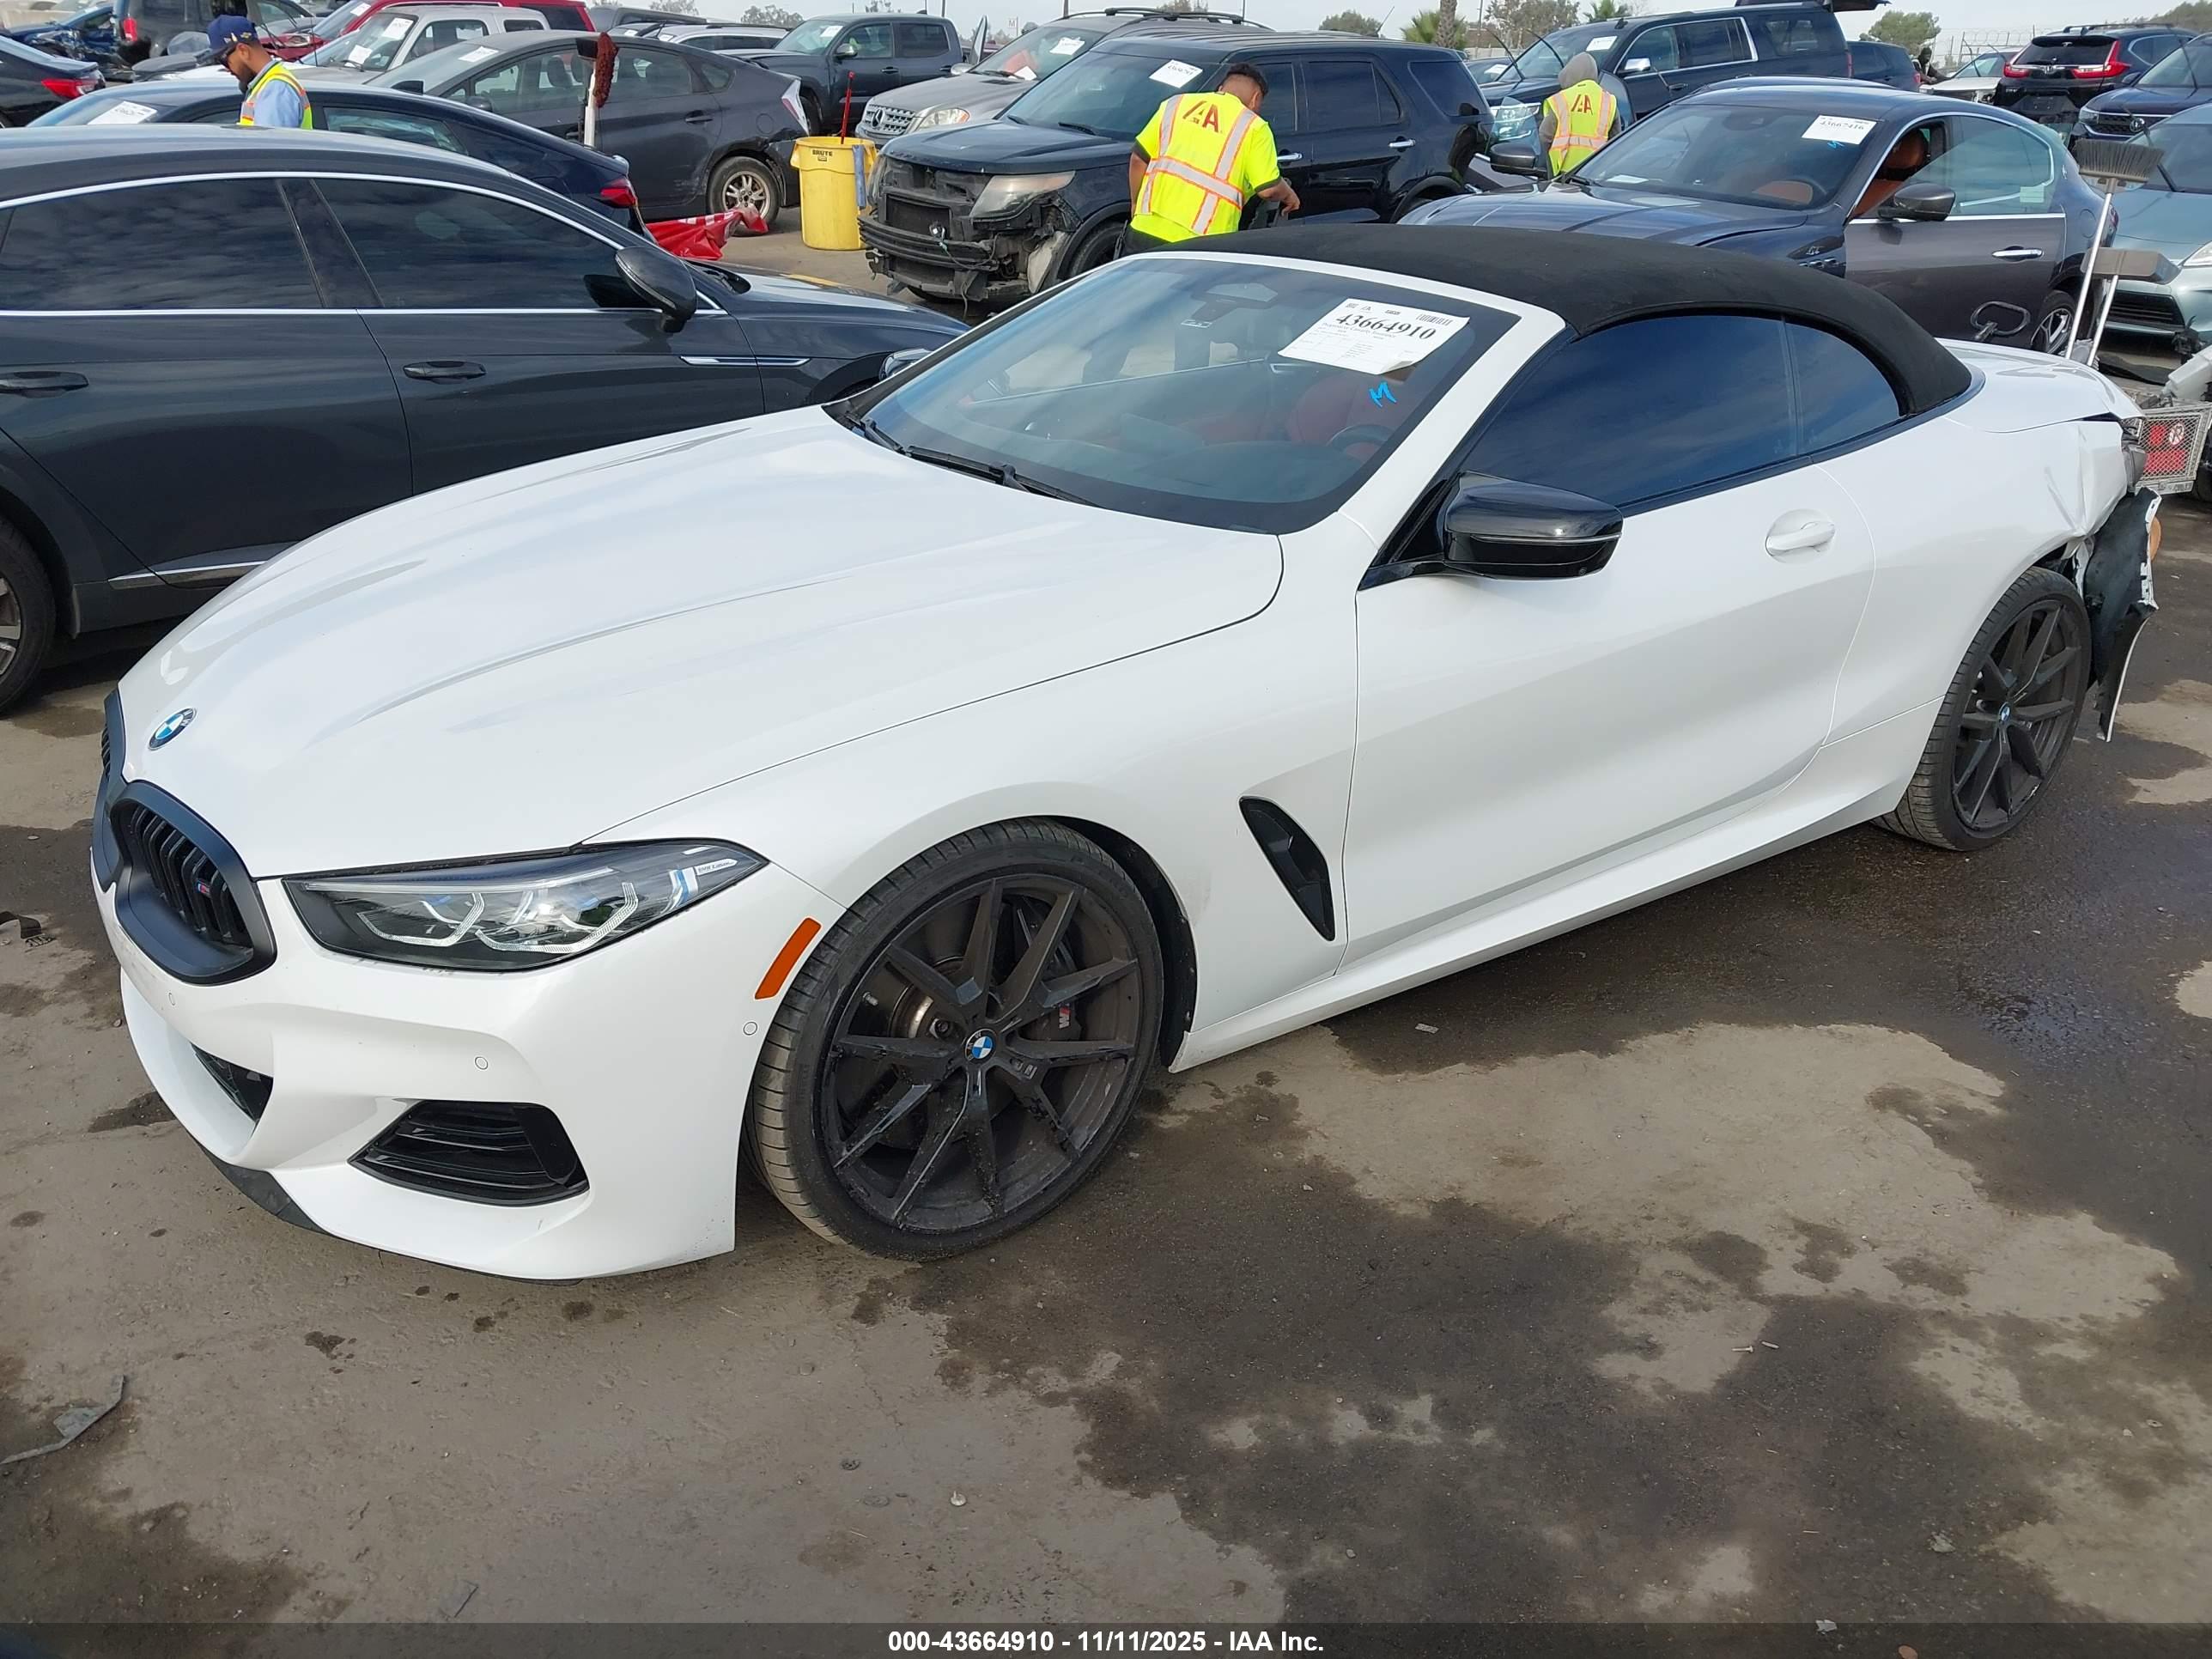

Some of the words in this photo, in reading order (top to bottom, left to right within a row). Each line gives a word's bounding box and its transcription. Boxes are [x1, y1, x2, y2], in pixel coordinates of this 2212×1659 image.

[811, 149, 834, 157] BRUTE
[1336, 313, 1437, 340] 43664910
[1368, 380, 1398, 408] M
